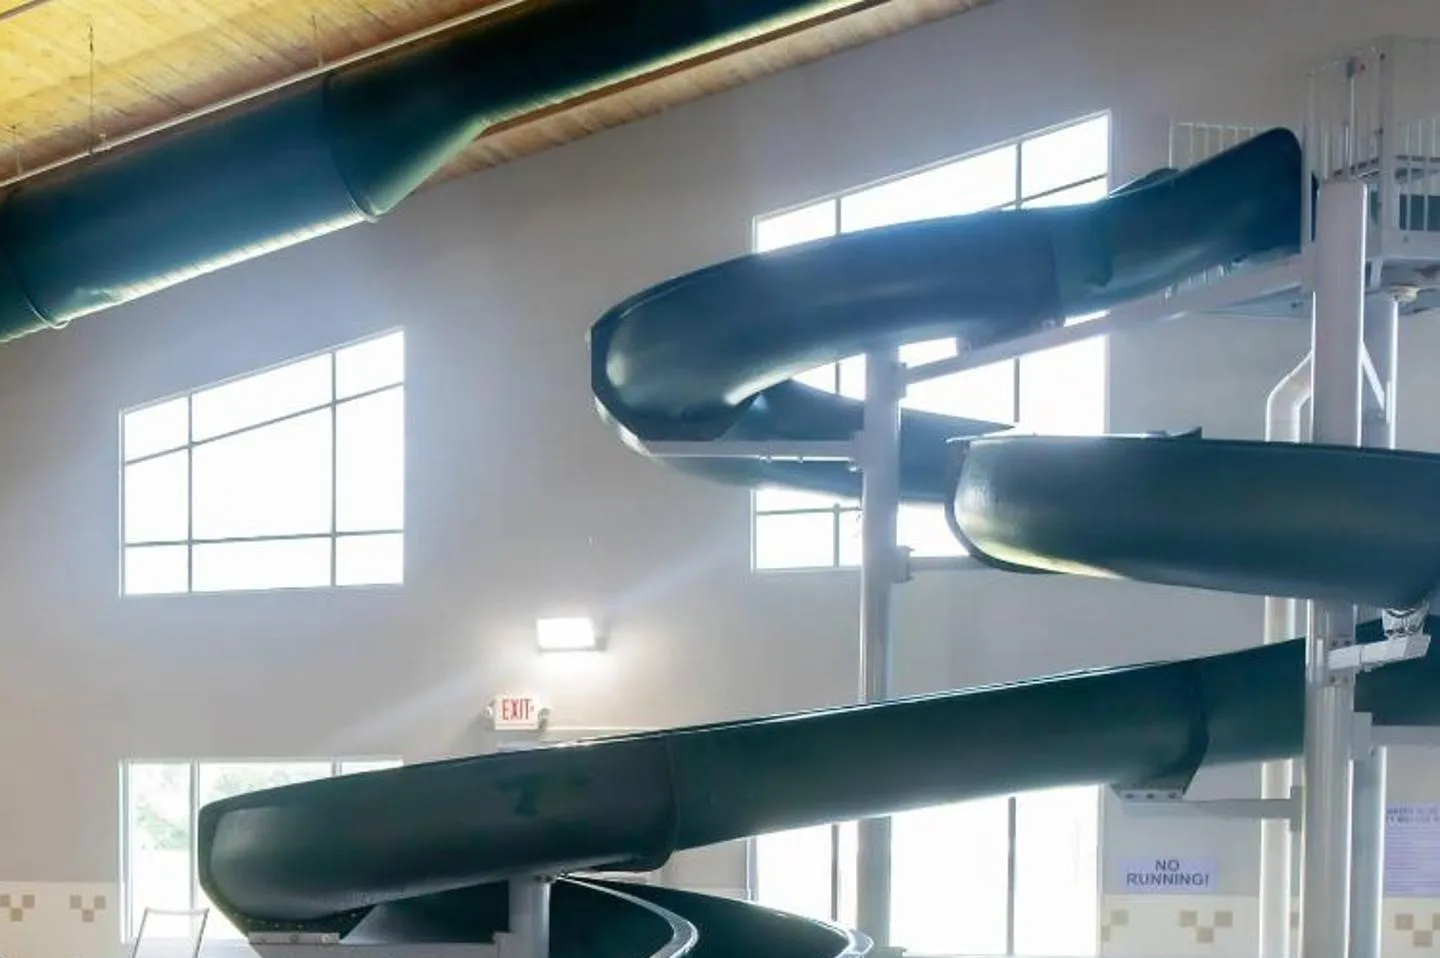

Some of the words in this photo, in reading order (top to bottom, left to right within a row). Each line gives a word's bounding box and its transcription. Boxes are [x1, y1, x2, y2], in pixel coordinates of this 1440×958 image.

[502, 698, 533, 720] EXIT
[1155, 859, 1180, 872] NO
[1126, 872, 1209, 888] RUNNING!
